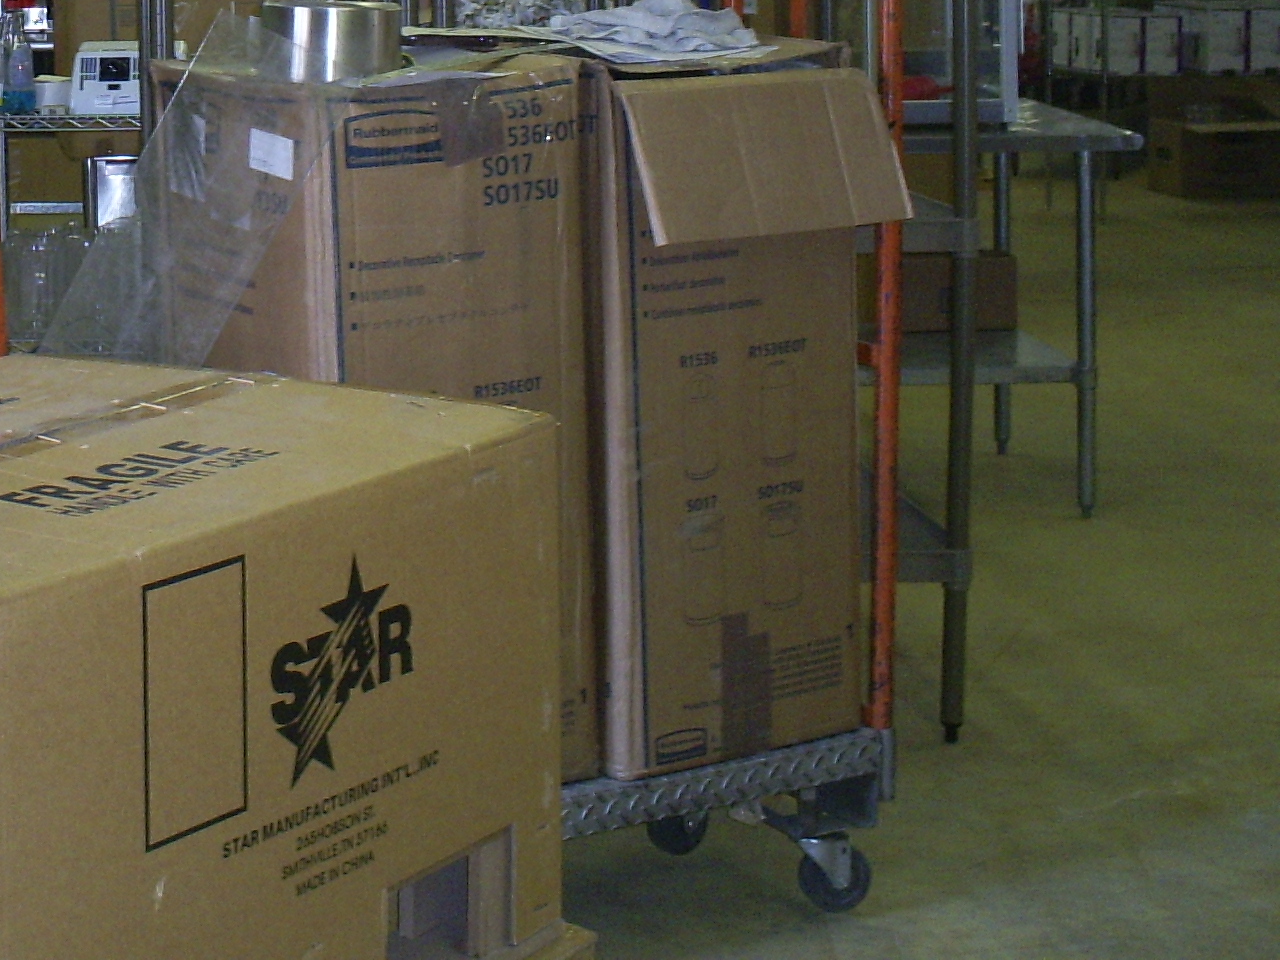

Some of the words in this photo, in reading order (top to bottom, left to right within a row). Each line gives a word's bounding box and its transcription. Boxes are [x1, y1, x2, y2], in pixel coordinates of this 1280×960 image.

[353, 123, 438, 139] Rubbermaid
[505, 97, 543, 119] 536
[46, 488, 158, 517] HANDLE
[140, 468, 217, 488] WITH
[202, 447, 280, 469] CARE
[270, 603, 414, 726] STAR
[222, 829, 259, 859] STAR
[263, 777, 379, 841] MANUFACTURING
